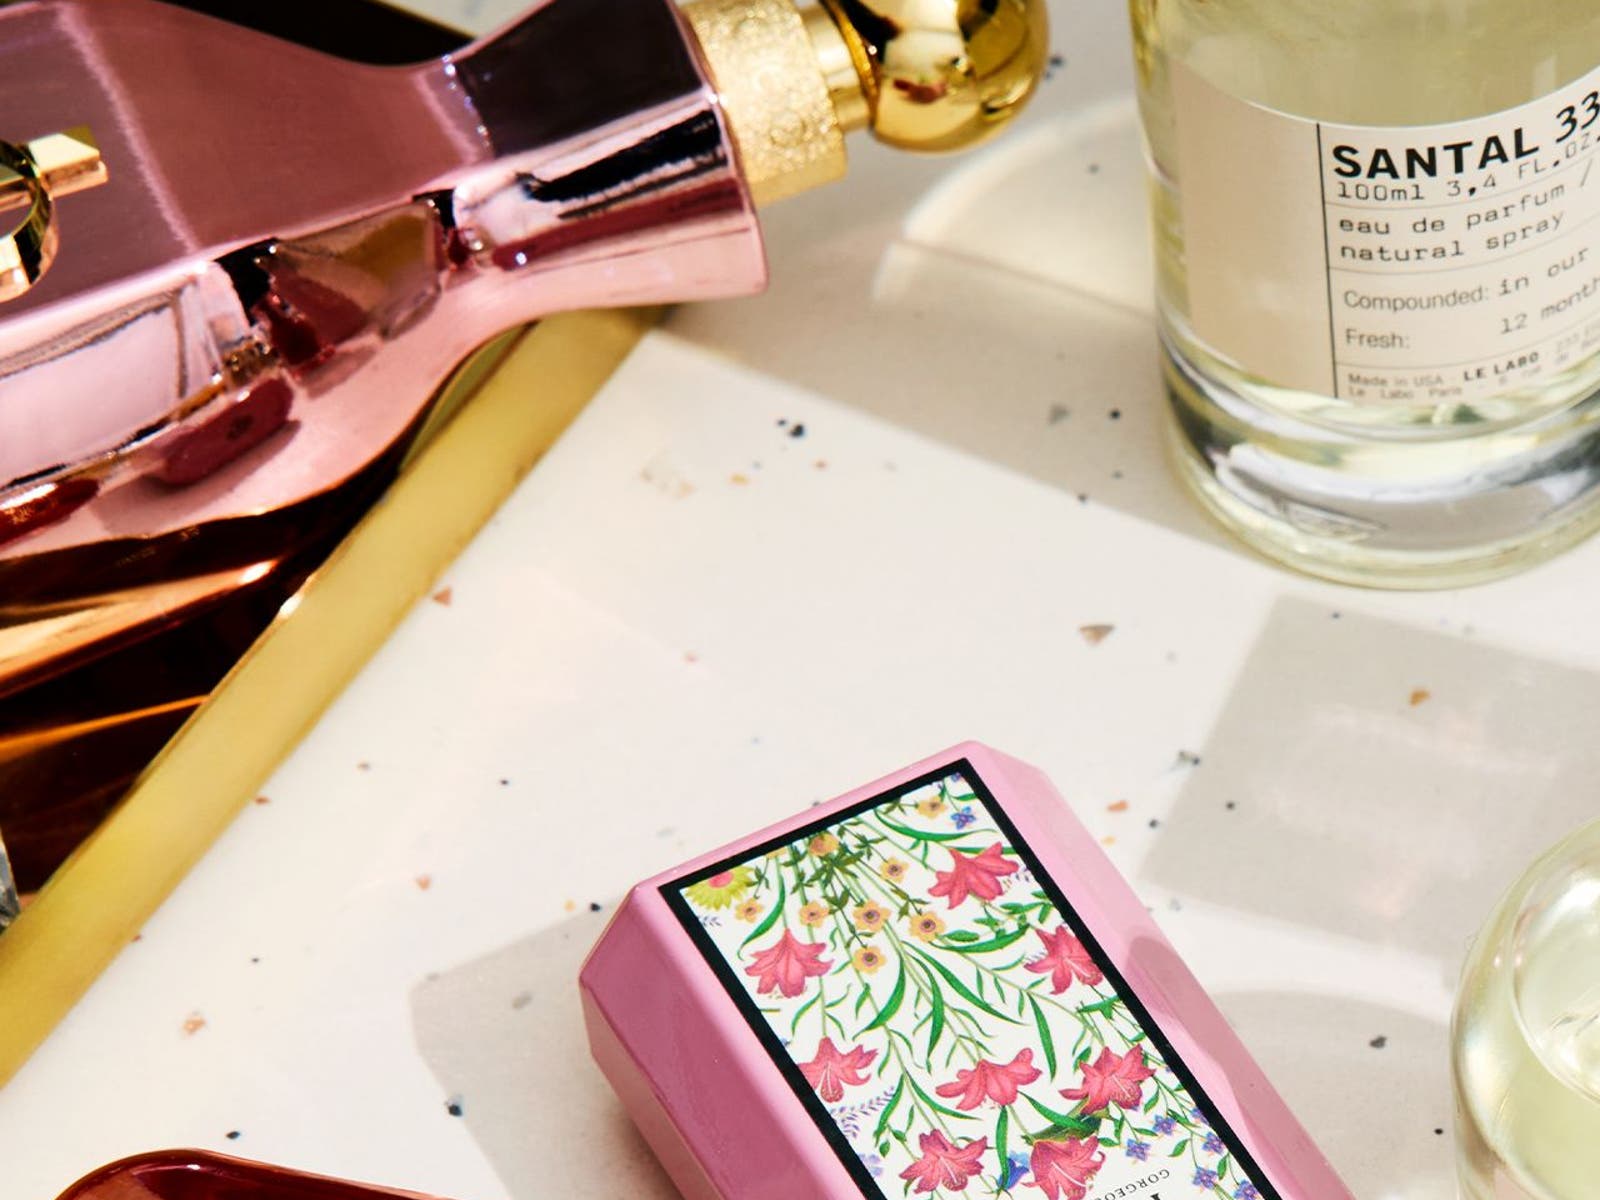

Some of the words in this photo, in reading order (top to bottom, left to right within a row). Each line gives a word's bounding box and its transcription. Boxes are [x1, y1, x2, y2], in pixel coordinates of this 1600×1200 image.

[1332, 127, 1540, 179] SANTAL
[1556, 90, 1600, 143] 33
[1337, 181, 1425, 201] 100ml
[1339, 218, 1391, 235] eau
[1412, 217, 1446, 233] de
[1466, 184, 1565, 230] parfum
[1340, 240, 1465, 262] natural
[1486, 210, 1565, 250] spray
[1343, 285, 1490, 313] Compounded:
[1499, 275, 1530, 297] in
[1547, 247, 1589, 278] our
[1345, 328, 1411, 350] Fresh:
[1500, 312, 1528, 335] 12
[1348, 372, 1388, 387] Made
[1413, 374, 1444, 386] USA
[1463, 366, 1487, 382] LE
[1493, 352, 1540, 376] LABO
